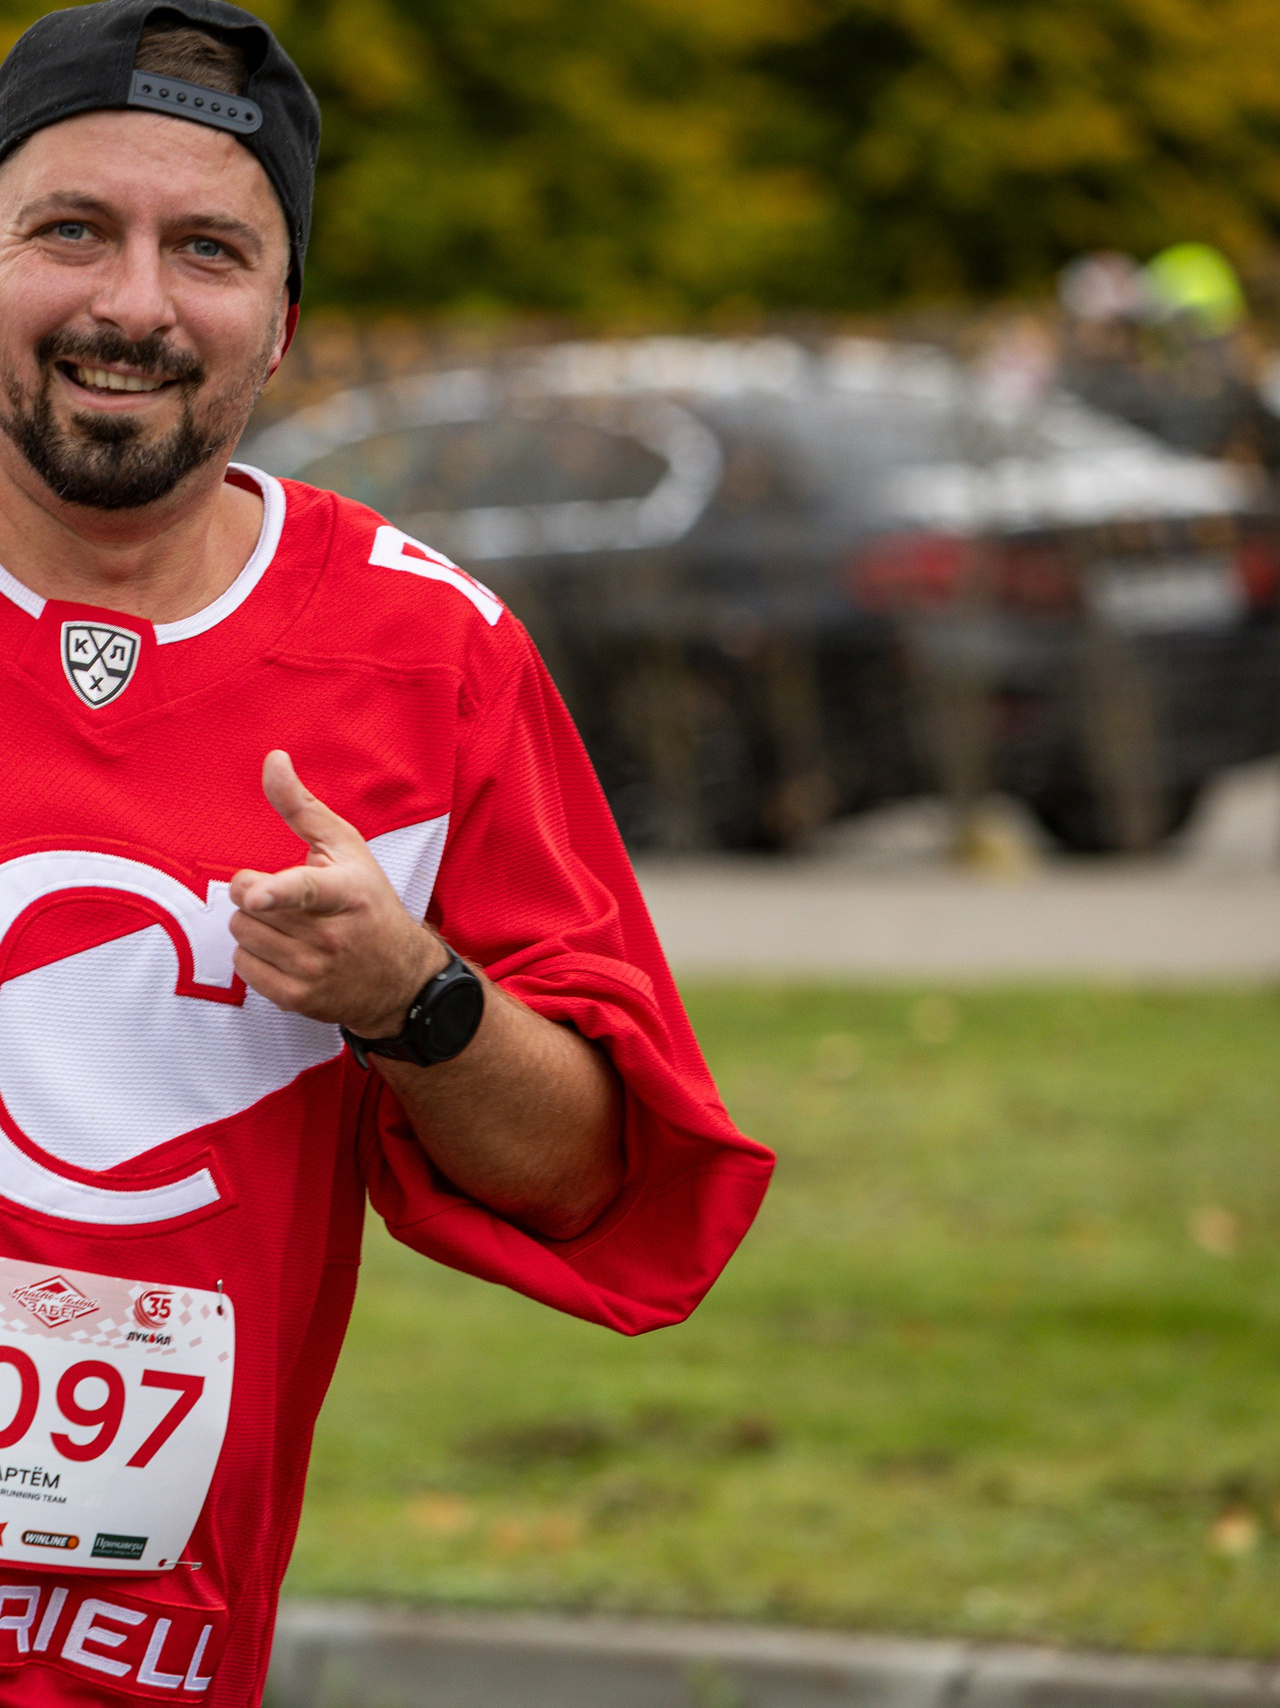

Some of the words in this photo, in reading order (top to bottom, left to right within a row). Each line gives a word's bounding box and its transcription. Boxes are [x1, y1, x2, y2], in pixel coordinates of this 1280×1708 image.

[26, 1301, 80, 1320] ЗАБЕГ
[146, 1296, 173, 1319] 35
[0, 1488, 41, 1501] RUNNING
[43, 1494, 68, 1504] TEAM
[23, 1532, 70, 1547] WINLINE
